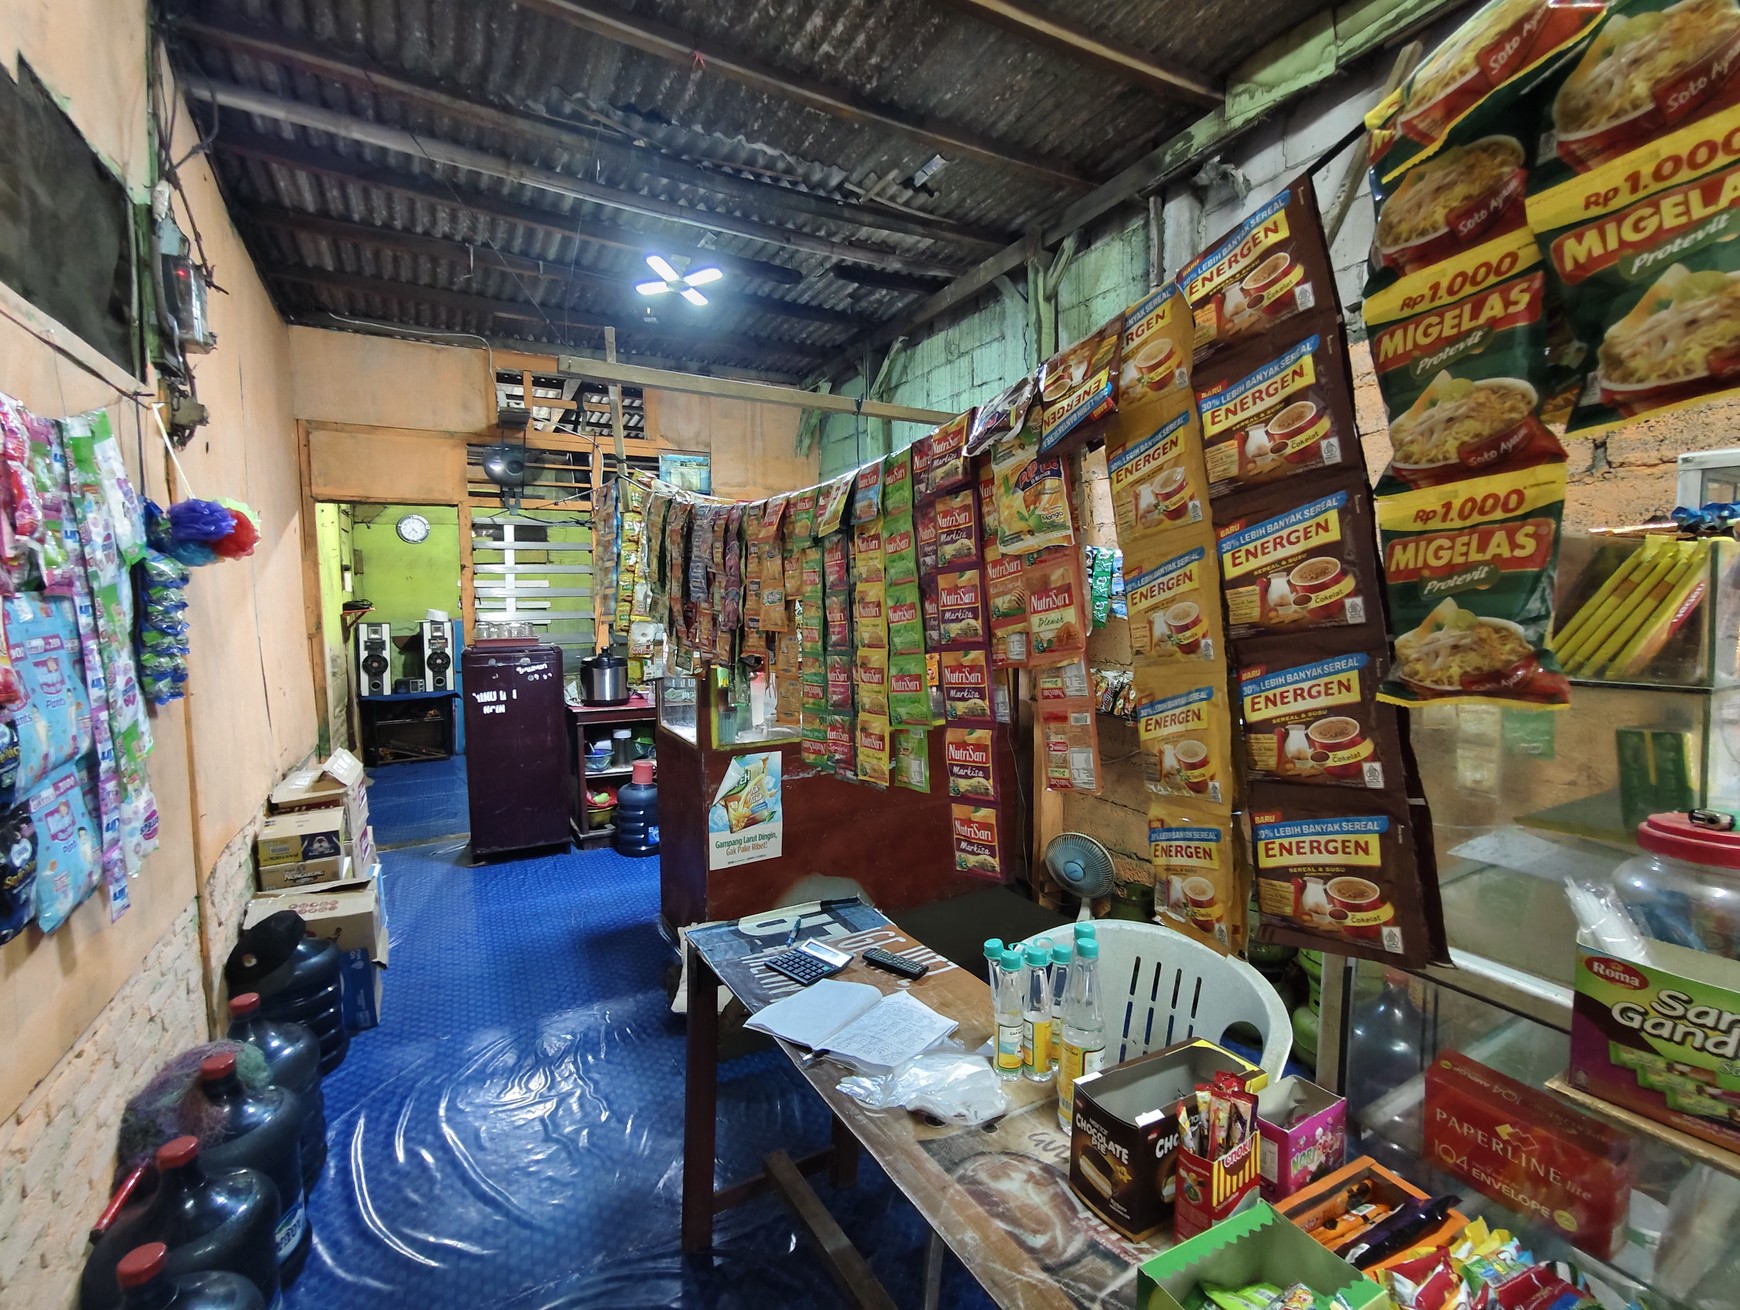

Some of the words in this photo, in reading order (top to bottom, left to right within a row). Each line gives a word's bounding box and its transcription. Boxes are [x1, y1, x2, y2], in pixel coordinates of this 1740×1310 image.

[1666, 77, 1708, 113] Soto
[1458, 208, 1488, 236] Soto
[1489, 180, 1520, 211] Ayam
[1198, 253, 1220, 274] LEBIH
[1250, 199, 1285, 227] SEREAL
[1631, 212, 1731, 275] Protevit
[1189, 221, 1279, 297] ENERGEN
[1145, 290, 1171, 315] SEREAL
[1379, 281, 1532, 363] MIGELAS
[1417, 328, 1486, 375] Protevit
[1202, 399, 1220, 412] 30%
[1221, 386, 1245, 403] LEBIH
[1246, 364, 1280, 388] BANYAK
[1280, 342, 1312, 368] SEREAL
[1043, 378, 1102, 431] ENERGEN
[1211, 364, 1305, 426] ENERGEN
[1291, 431, 1319, 449] Cokelat
[1116, 436, 1178, 485] ENERGEN
[1469, 451, 1497, 467] Soto
[937, 510, 969, 528] NutriSari
[1042, 511, 1064, 521] Mango
[1240, 527, 1265, 543] LEBIH
[1267, 512, 1302, 532] BANYAK
[1304, 499, 1338, 518] SEREAL
[1231, 518, 1330, 568] ENERGEN
[1390, 525, 1537, 572] MIGELAS
[987, 559, 1022, 580] NutriSari
[1424, 565, 1490, 595] Protevit
[941, 589, 975, 606] NutriSari
[1131, 570, 1193, 607] ENERGEN
[1315, 589, 1343, 604] Cokelat
[1031, 590, 1070, 612] NutriSari
[891, 677, 920, 692] NutriSari
[944, 667, 981, 684] NutriSari
[1260, 677, 1285, 690] LEBIH
[1287, 667, 1322, 682] BANYAK
[1323, 658, 1359, 673] SEREAL
[950, 689, 980, 699] Markisa
[1250, 678, 1352, 713] ENERGEN
[1144, 708, 1202, 732] ENERGEN
[948, 744, 986, 763] NutriSari
[1333, 752, 1361, 763] Cokelat
[952, 766, 984, 777] Markisa
[955, 819, 991, 842] NutriSari
[1255, 815, 1275, 824] BARU
[1274, 826, 1301, 837] LEBIH
[1302, 824, 1339, 834] BANYAK
[1342, 822, 1379, 831] SEREAL
[715, 837, 743, 849] Gampang
[743, 834, 757, 844] Larut
[758, 831, 777, 842] Dingin,
[726, 846, 736, 856] Gak
[738, 843, 751, 854] Pake
[960, 841, 991, 855] Markisa
[1264, 839, 1370, 858] ENERGEN
[1154, 844, 1213, 860] ENERGEN
[1352, 915, 1381, 924] Cokelat
[1592, 961, 1640, 987] Roma
[1076, 1113, 1129, 1165] CHOCOLATE
[1091, 1136, 1107, 1155] PIE
[1435, 1108, 1562, 1186] PAPERLINE
[1472, 1168, 1551, 1219] ENVELOPE
